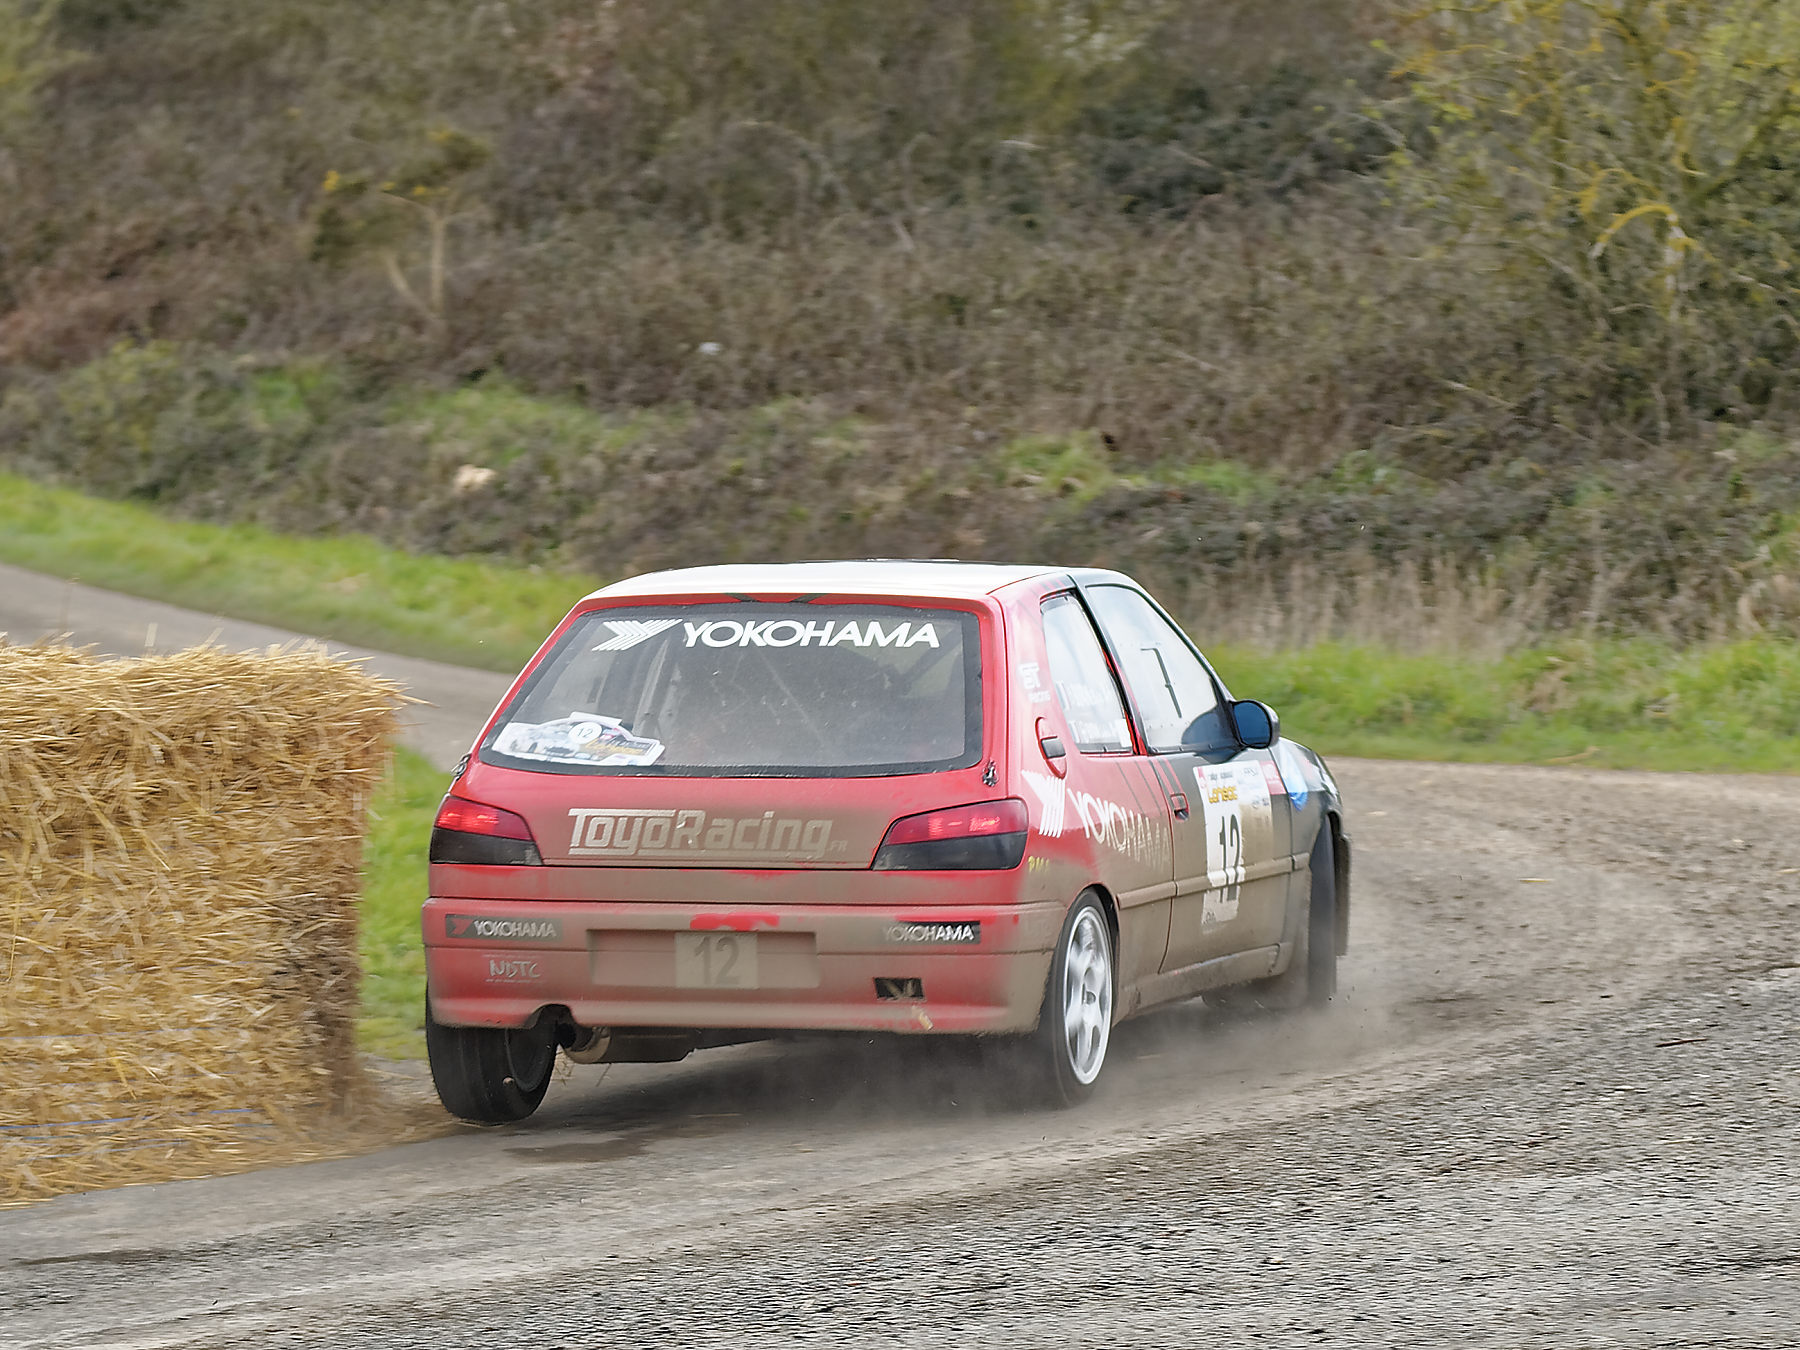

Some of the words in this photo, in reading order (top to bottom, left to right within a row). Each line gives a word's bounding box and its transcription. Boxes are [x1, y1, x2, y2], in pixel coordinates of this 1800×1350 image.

[684, 620, 940, 648] YOKOHAMA
[577, 727, 594, 738] 12
[1219, 814, 1241, 904] 12
[474, 920, 557, 938] YOKOHAMA
[884, 924, 975, 941] YOKOHAMA
[694, 935, 741, 986] 12
